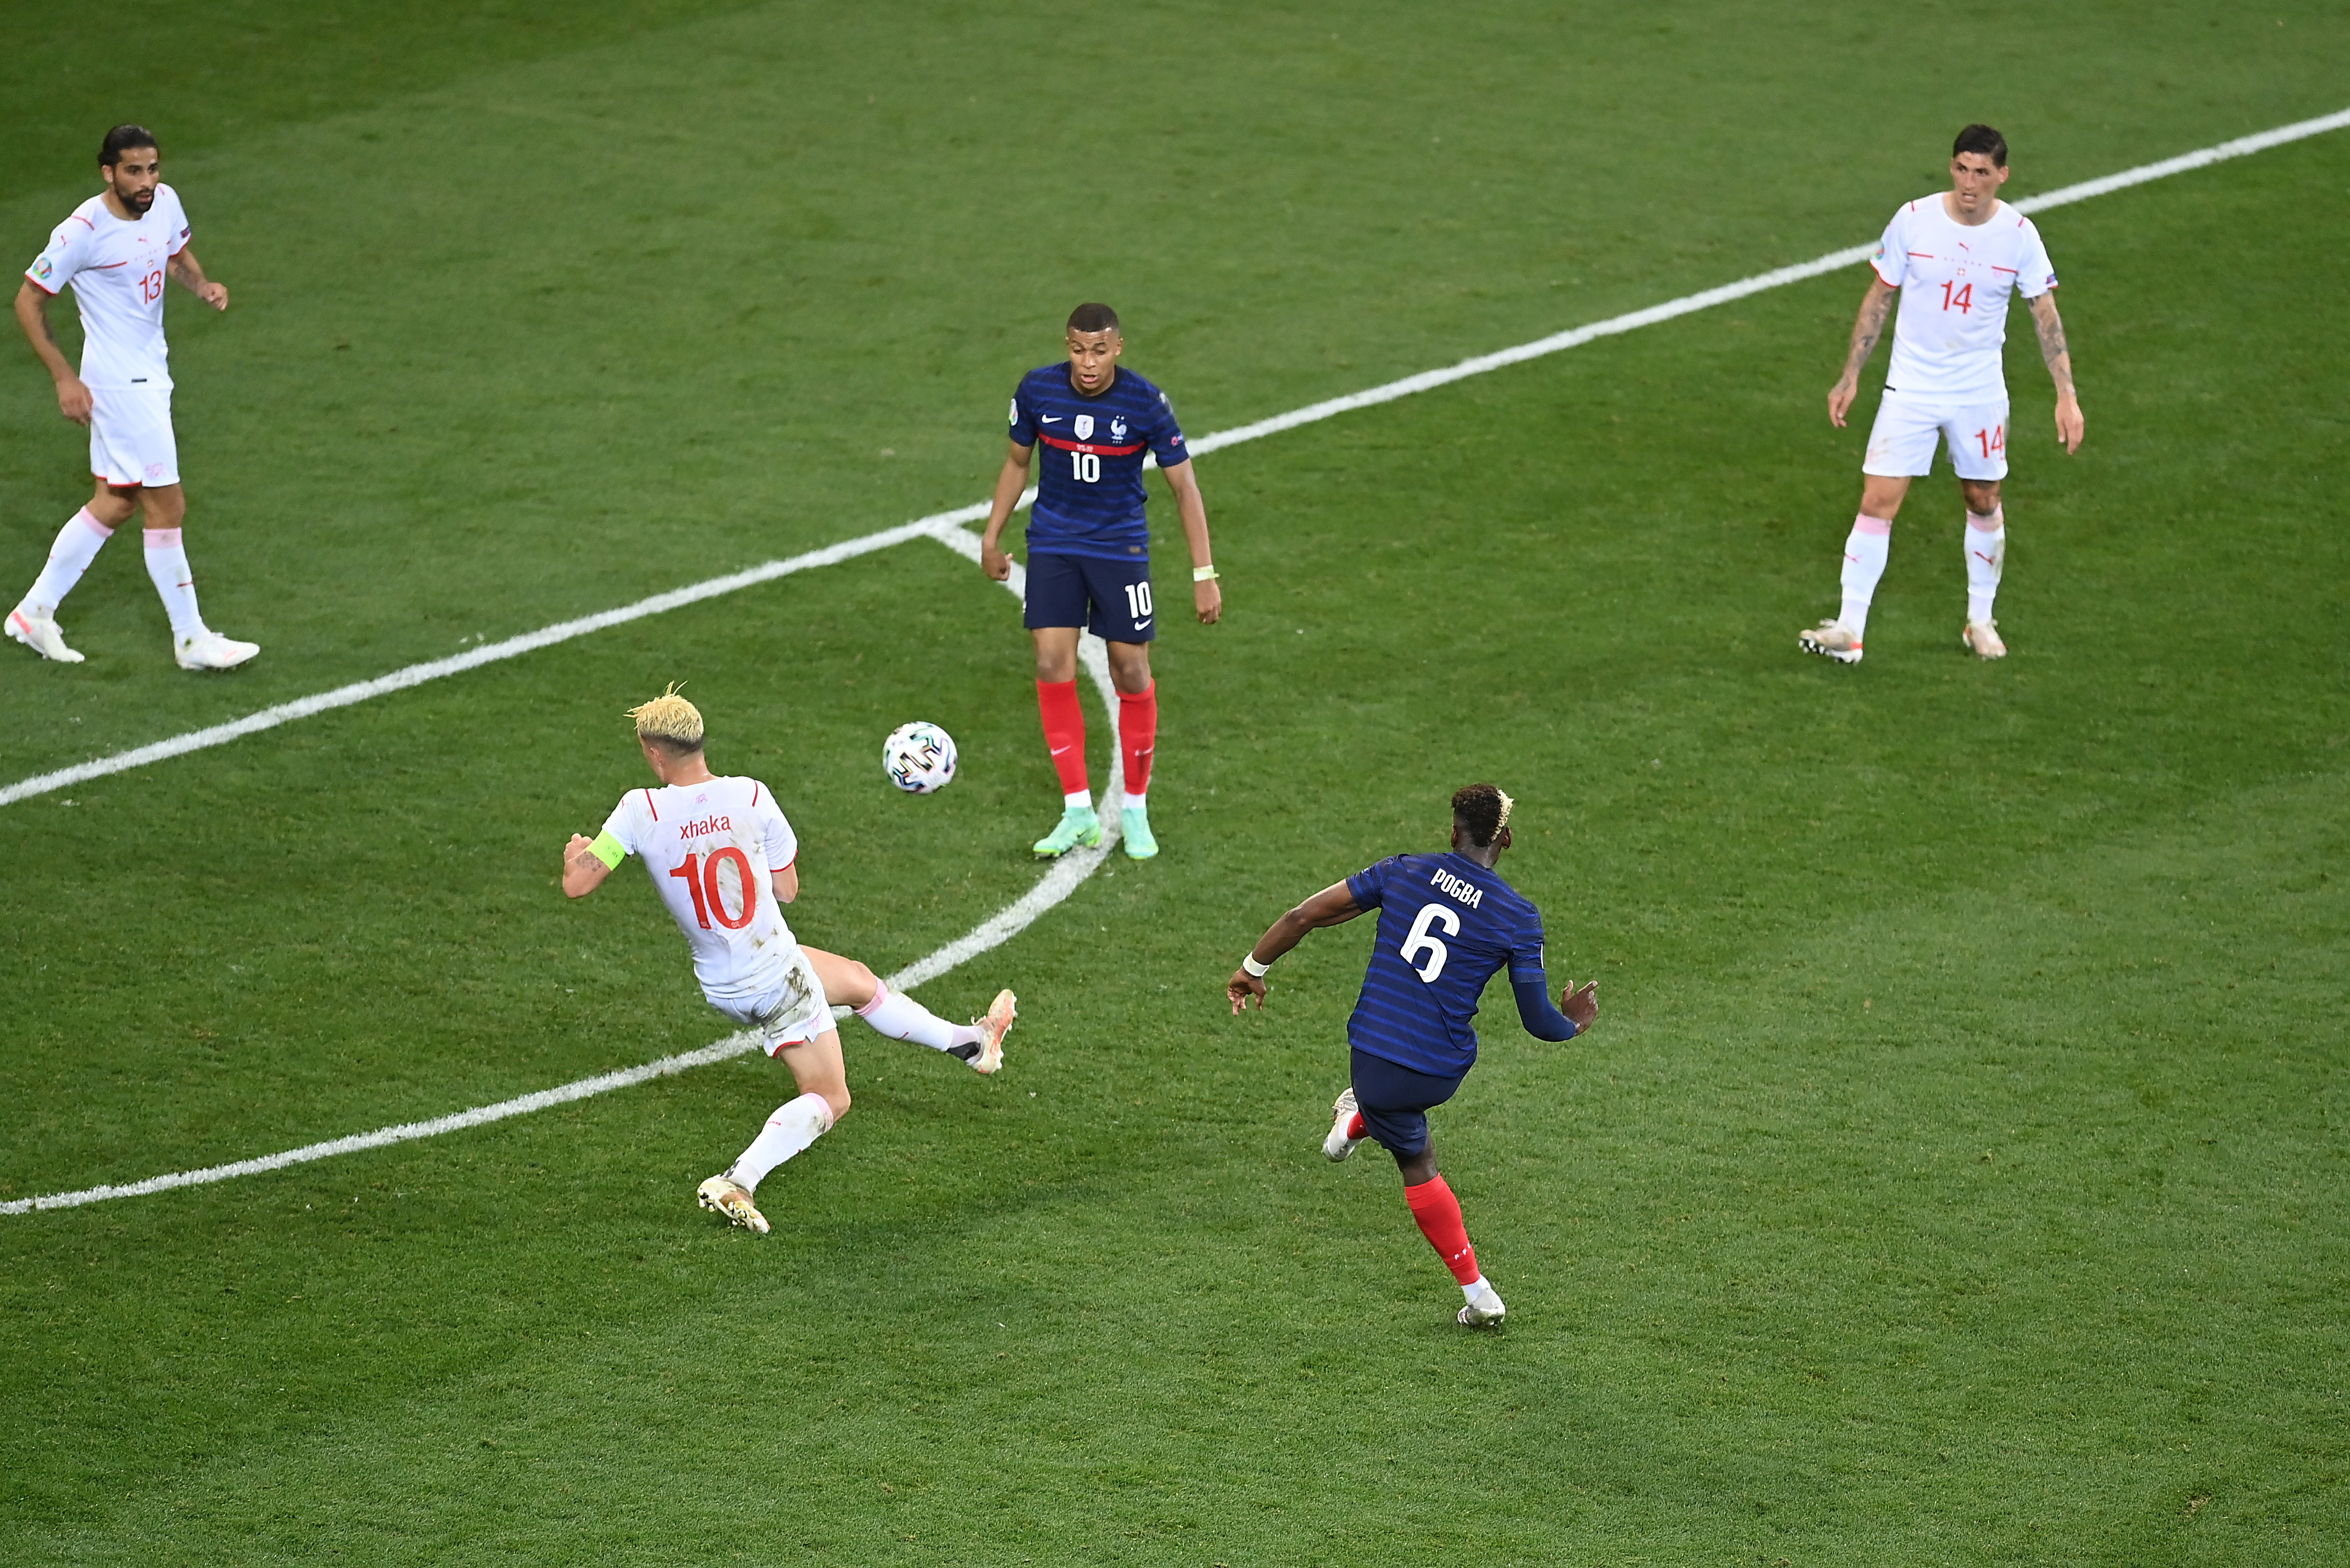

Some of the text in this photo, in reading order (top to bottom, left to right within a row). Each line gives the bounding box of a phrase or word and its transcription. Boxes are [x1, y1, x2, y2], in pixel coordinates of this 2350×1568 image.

[139, 270, 162, 305] 13
[1940, 279, 1973, 314] 14
[1975, 425, 2004, 459] 14
[1071, 451, 1100, 483] 10
[1125, 581, 1152, 618] 10
[680, 815, 731, 840] xhaka
[670, 847, 756, 930] 10
[1430, 868, 1483, 909] POGBA
[1400, 903, 1460, 983] 6
